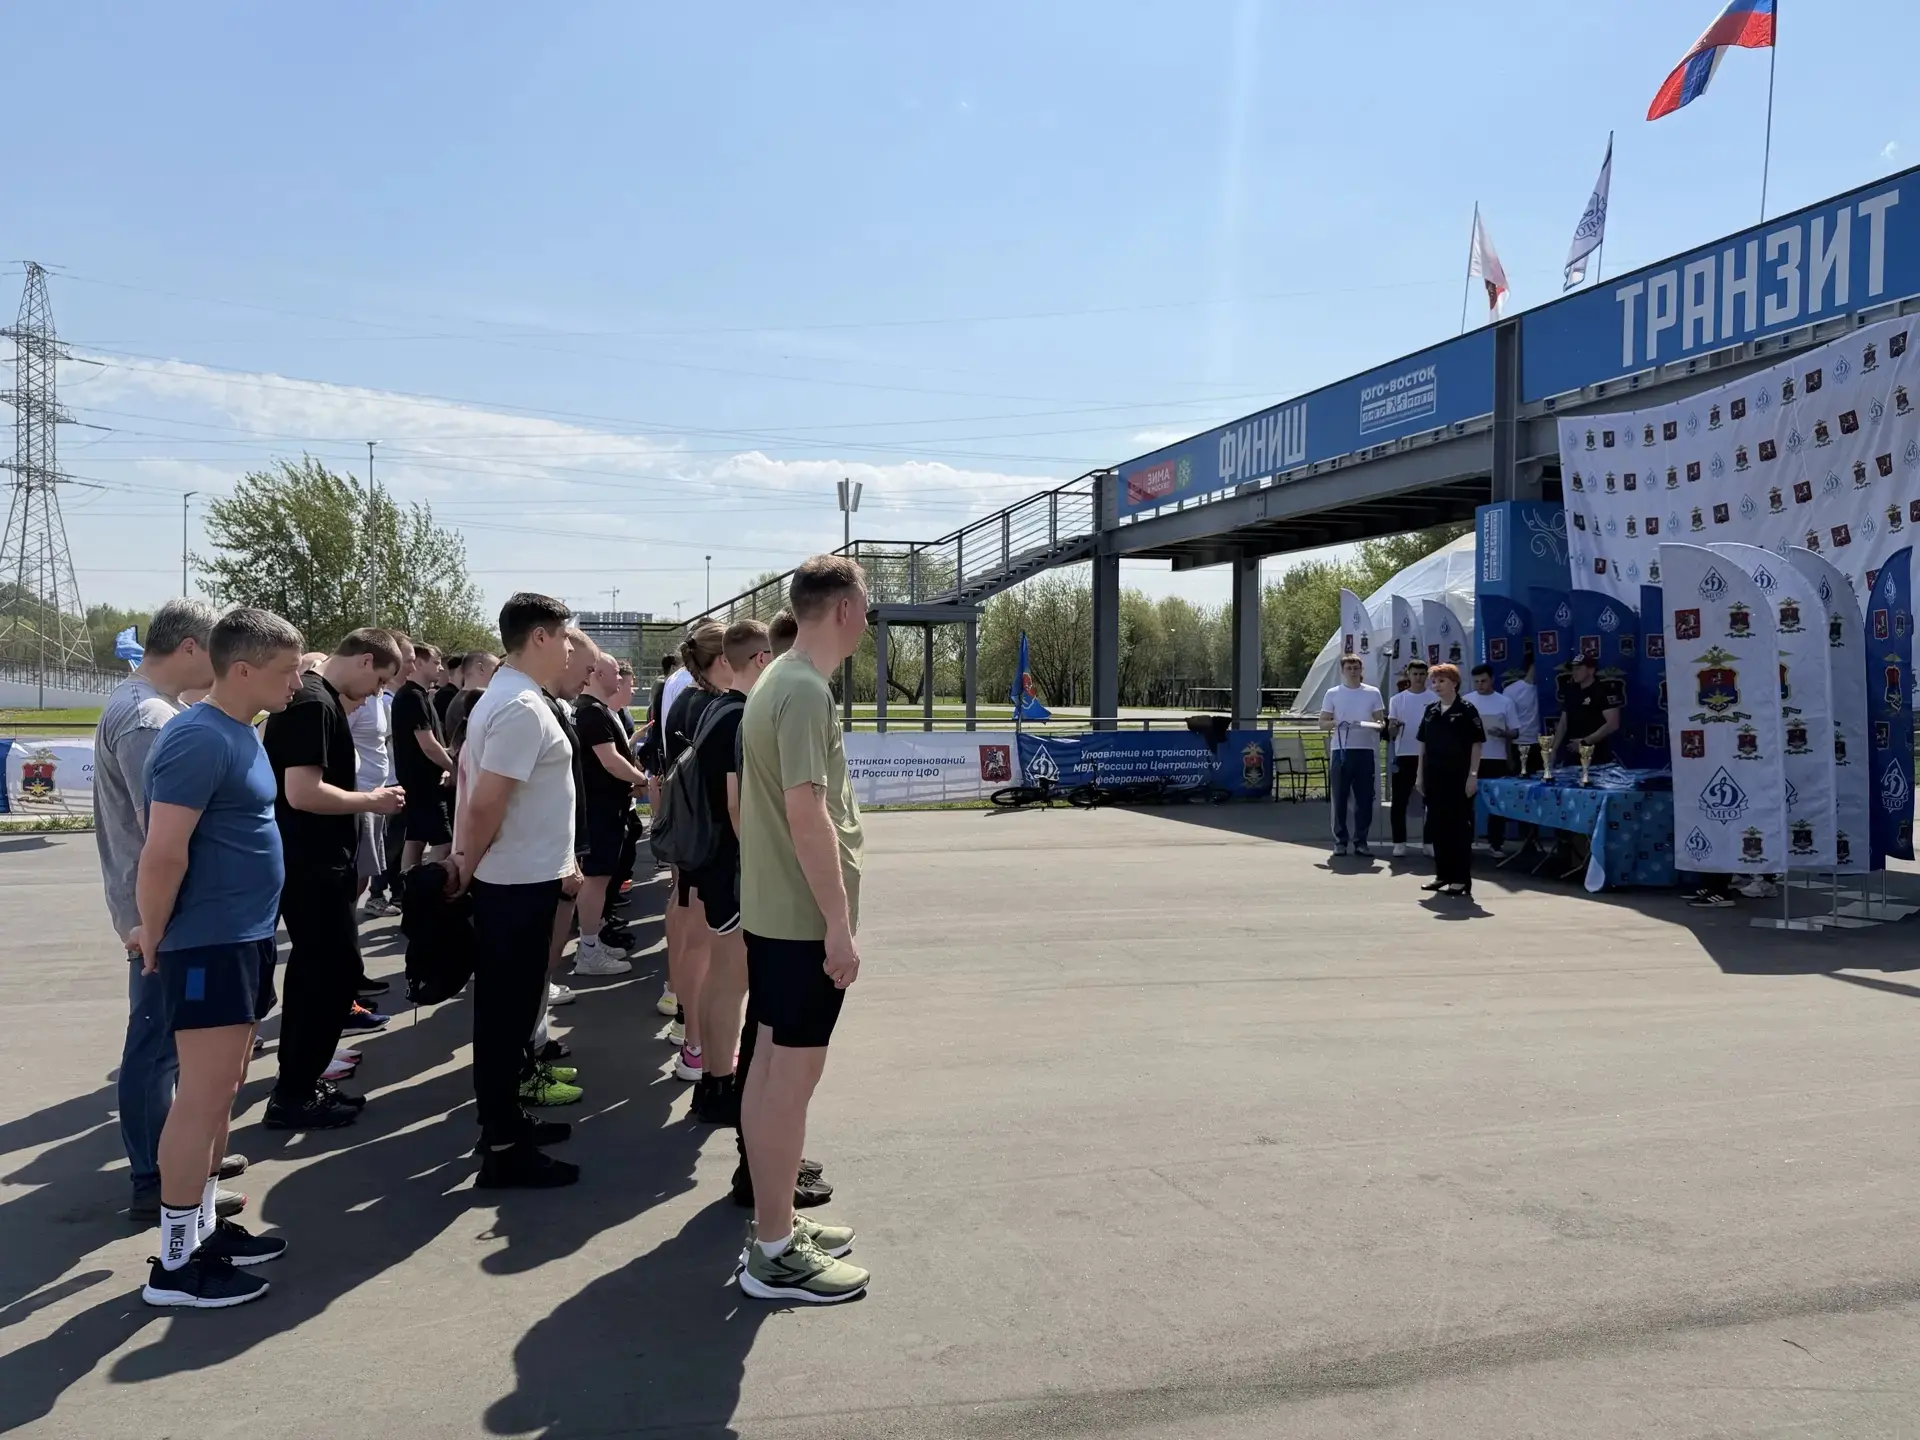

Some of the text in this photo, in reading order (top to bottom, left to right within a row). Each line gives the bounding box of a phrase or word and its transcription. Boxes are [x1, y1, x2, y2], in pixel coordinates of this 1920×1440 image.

[1615, 189, 1900, 368] ТРАНЗИТ
[1361, 364, 1437, 402] ЮГО-ВОСТОК
[1219, 402, 1307, 484] ФИНИШ
[1147, 467, 1170, 485] ЗИМА
[847, 756, 966, 766] стникам соревнований
[1080, 750, 1140, 759] Управление
[862, 769, 899, 777] России
[901, 769, 914, 777] по
[916, 768, 940, 778] ЦФО
[1073, 763, 1094, 773] МВД
[1097, 762, 1134, 771] России
[1710, 808, 1738, 819] МГО
[170, 1224, 186, 1247] NIKE
